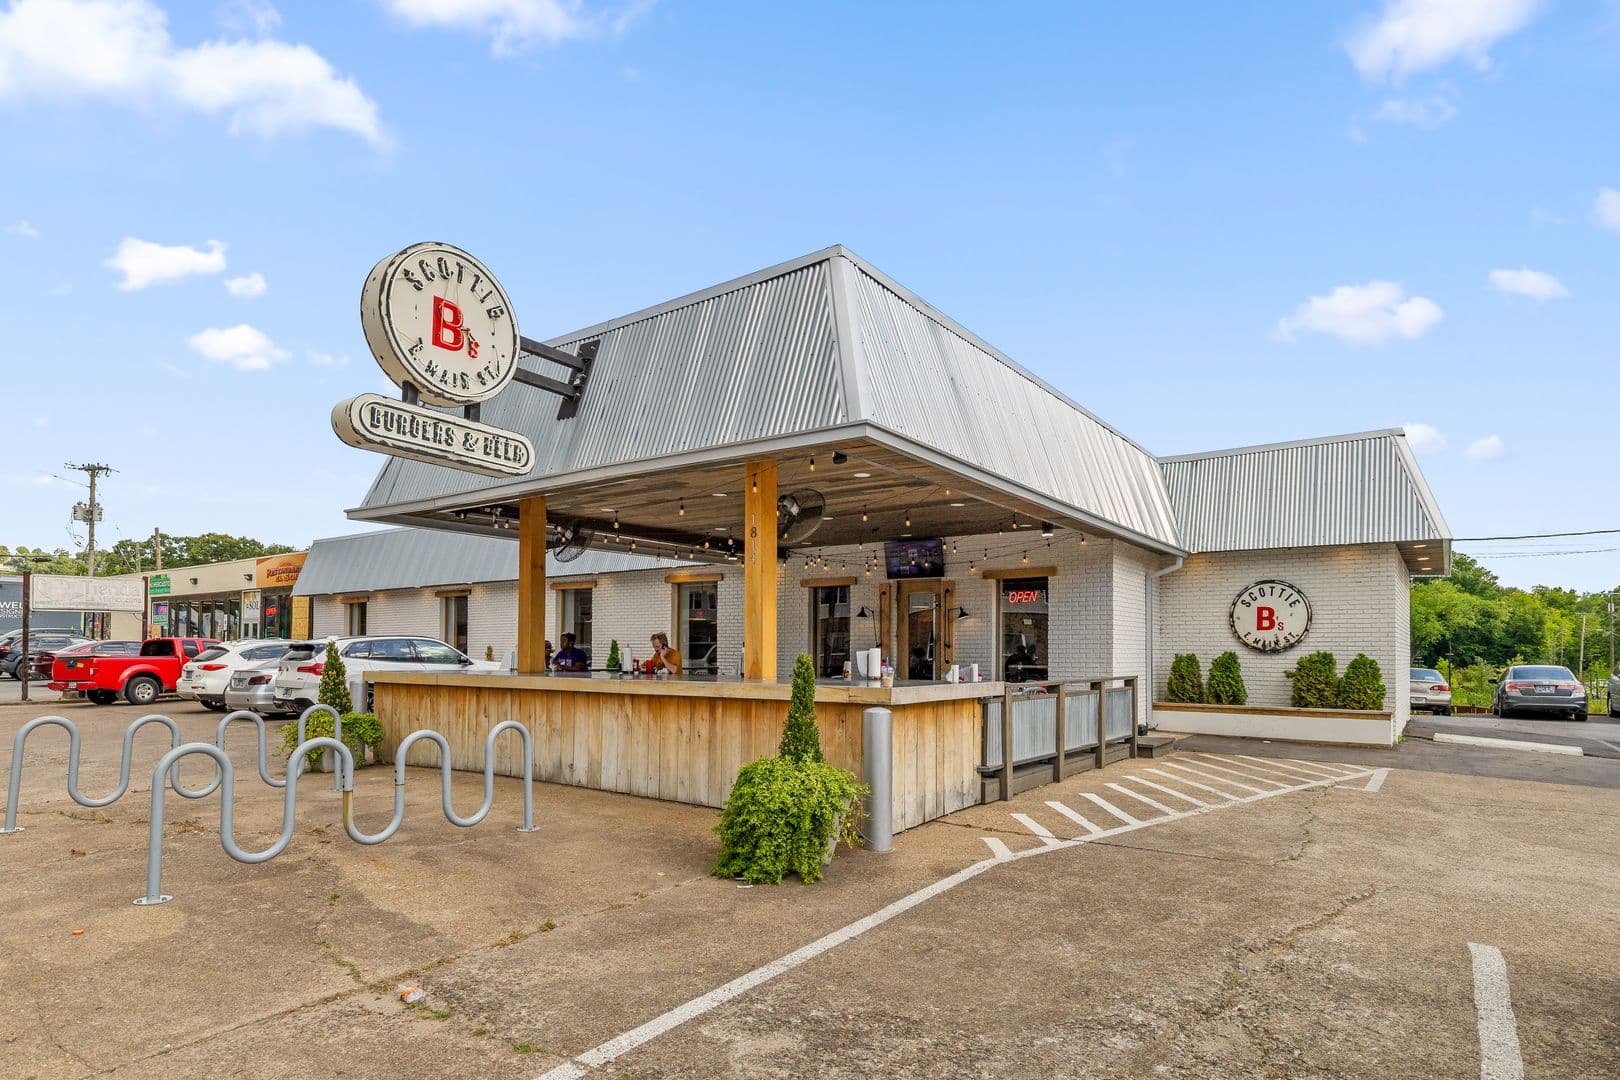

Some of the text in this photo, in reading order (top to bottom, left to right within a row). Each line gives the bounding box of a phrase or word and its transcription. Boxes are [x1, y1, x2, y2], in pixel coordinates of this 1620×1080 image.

[403, 256, 505, 319] SCOTTIE
[370, 405, 524, 464] BURGERS & BEER
[1009, 591, 1037, 603] OPEN
[1241, 586, 1301, 608] SCOTTIE
[1253, 637, 1280, 648] MAIN
